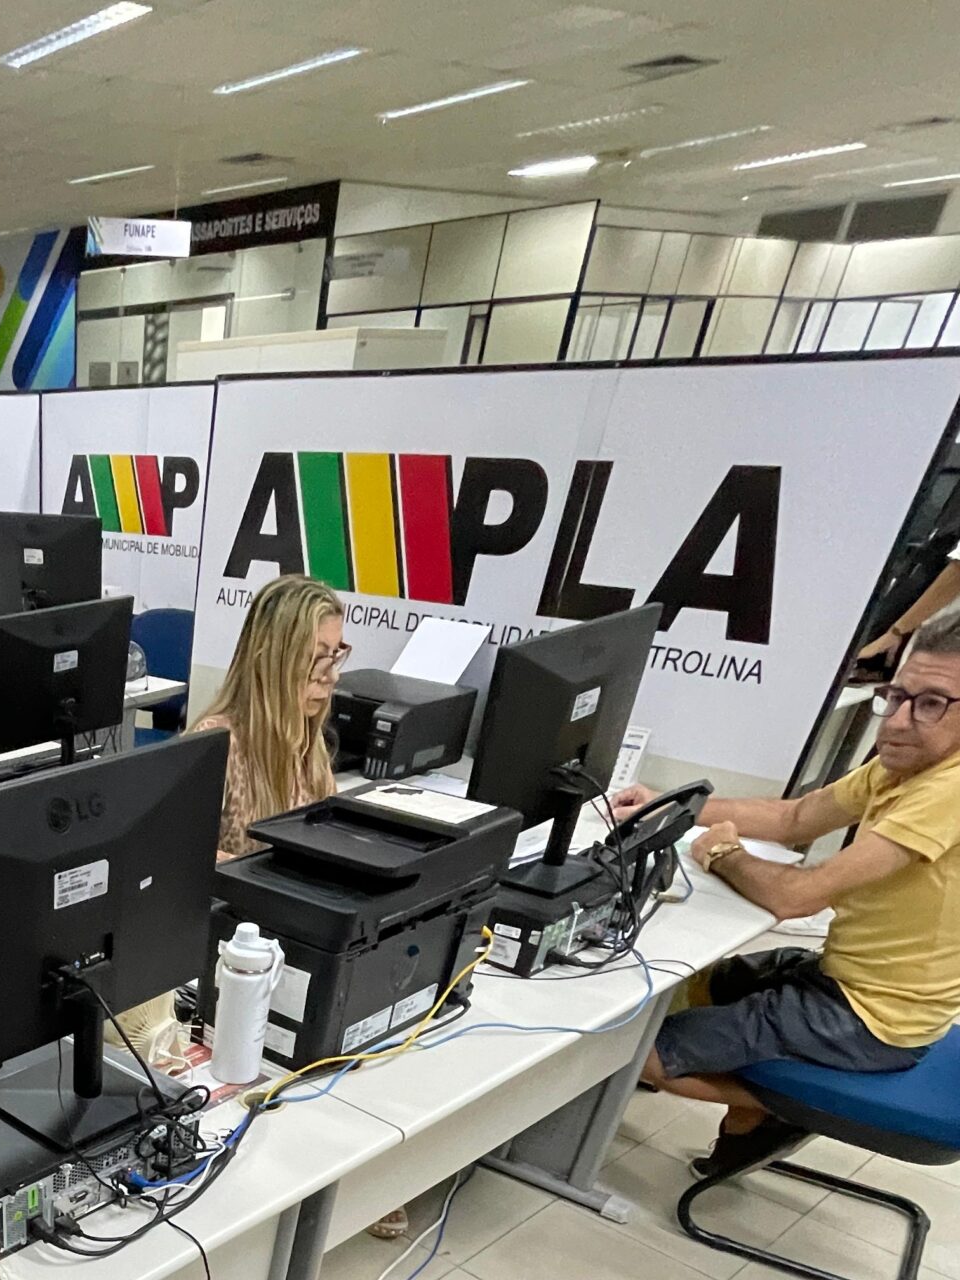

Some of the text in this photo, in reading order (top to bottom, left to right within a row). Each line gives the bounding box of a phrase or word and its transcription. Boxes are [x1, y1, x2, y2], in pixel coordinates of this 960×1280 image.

[255, 212, 263, 232] E
[264, 203, 320, 231] SERVIÇOS
[123, 223, 156, 239] FUNAPE
[102, 538, 200, 559] MUNICIPAL DE MOBILID
[76, 793, 105, 820] LG
